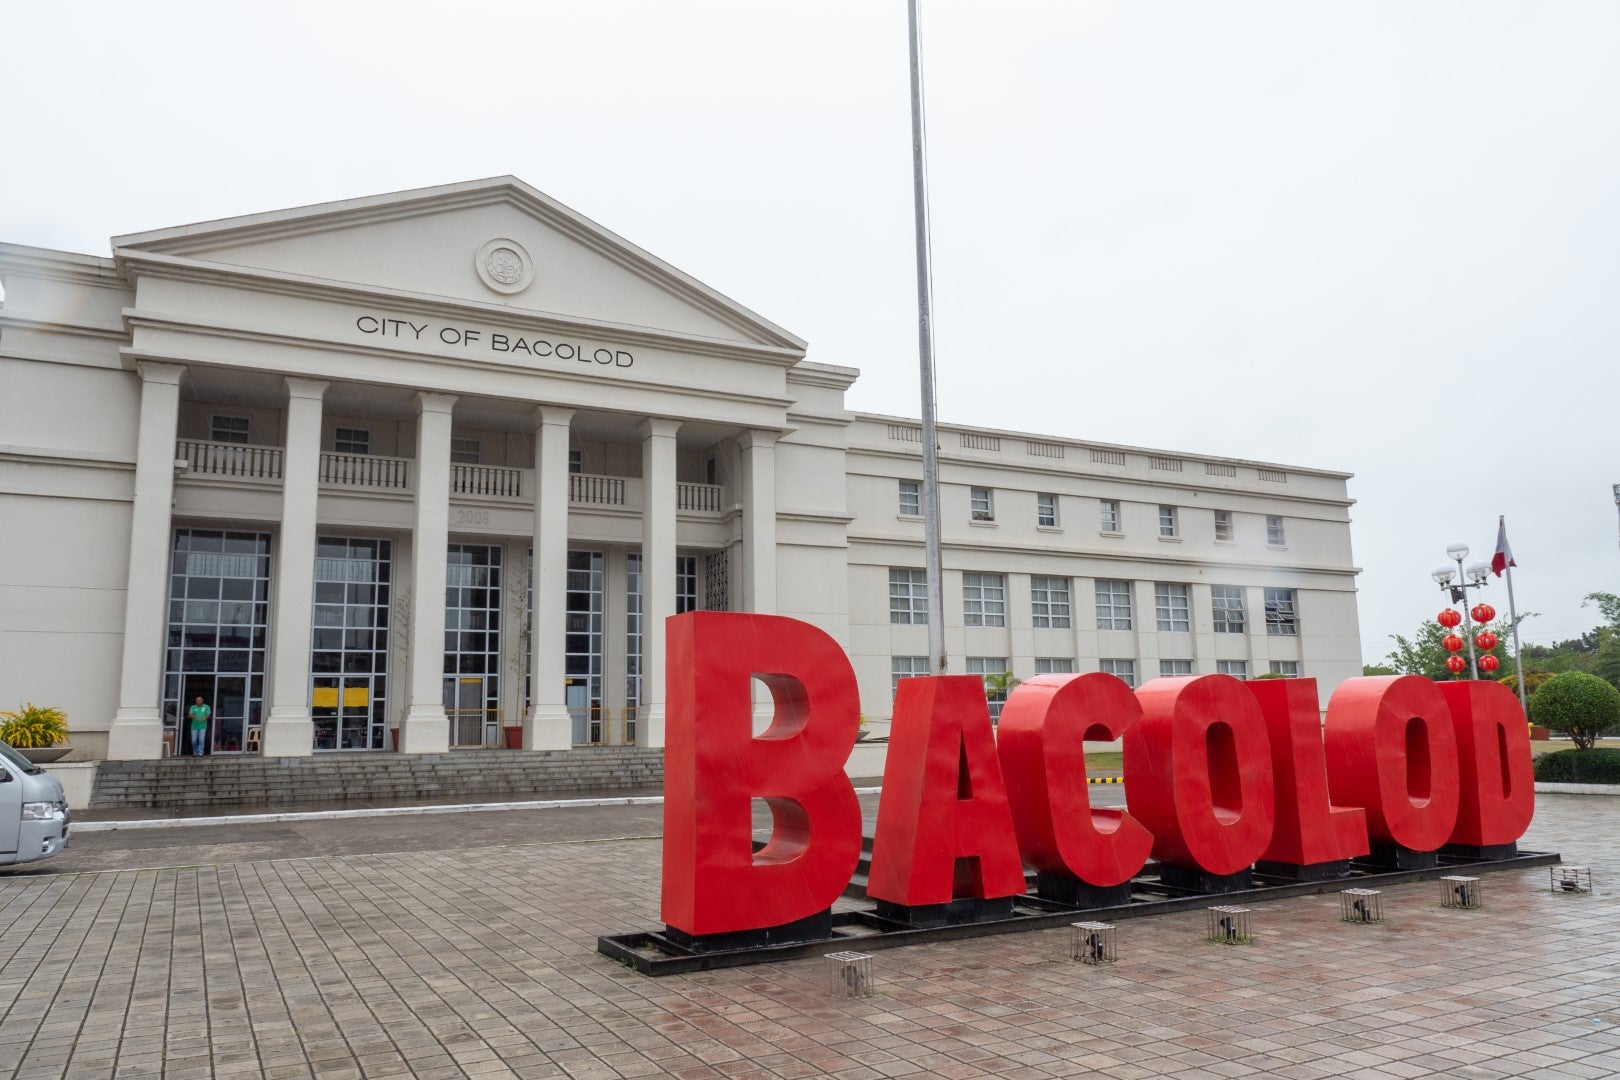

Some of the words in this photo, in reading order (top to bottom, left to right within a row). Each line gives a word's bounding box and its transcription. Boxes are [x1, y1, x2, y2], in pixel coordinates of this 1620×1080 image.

[356, 316, 428, 340] CITY
[439, 327, 481, 346] OF
[491, 333, 634, 368] BACOLOD
[661, 610, 1535, 936] BACOLOD
